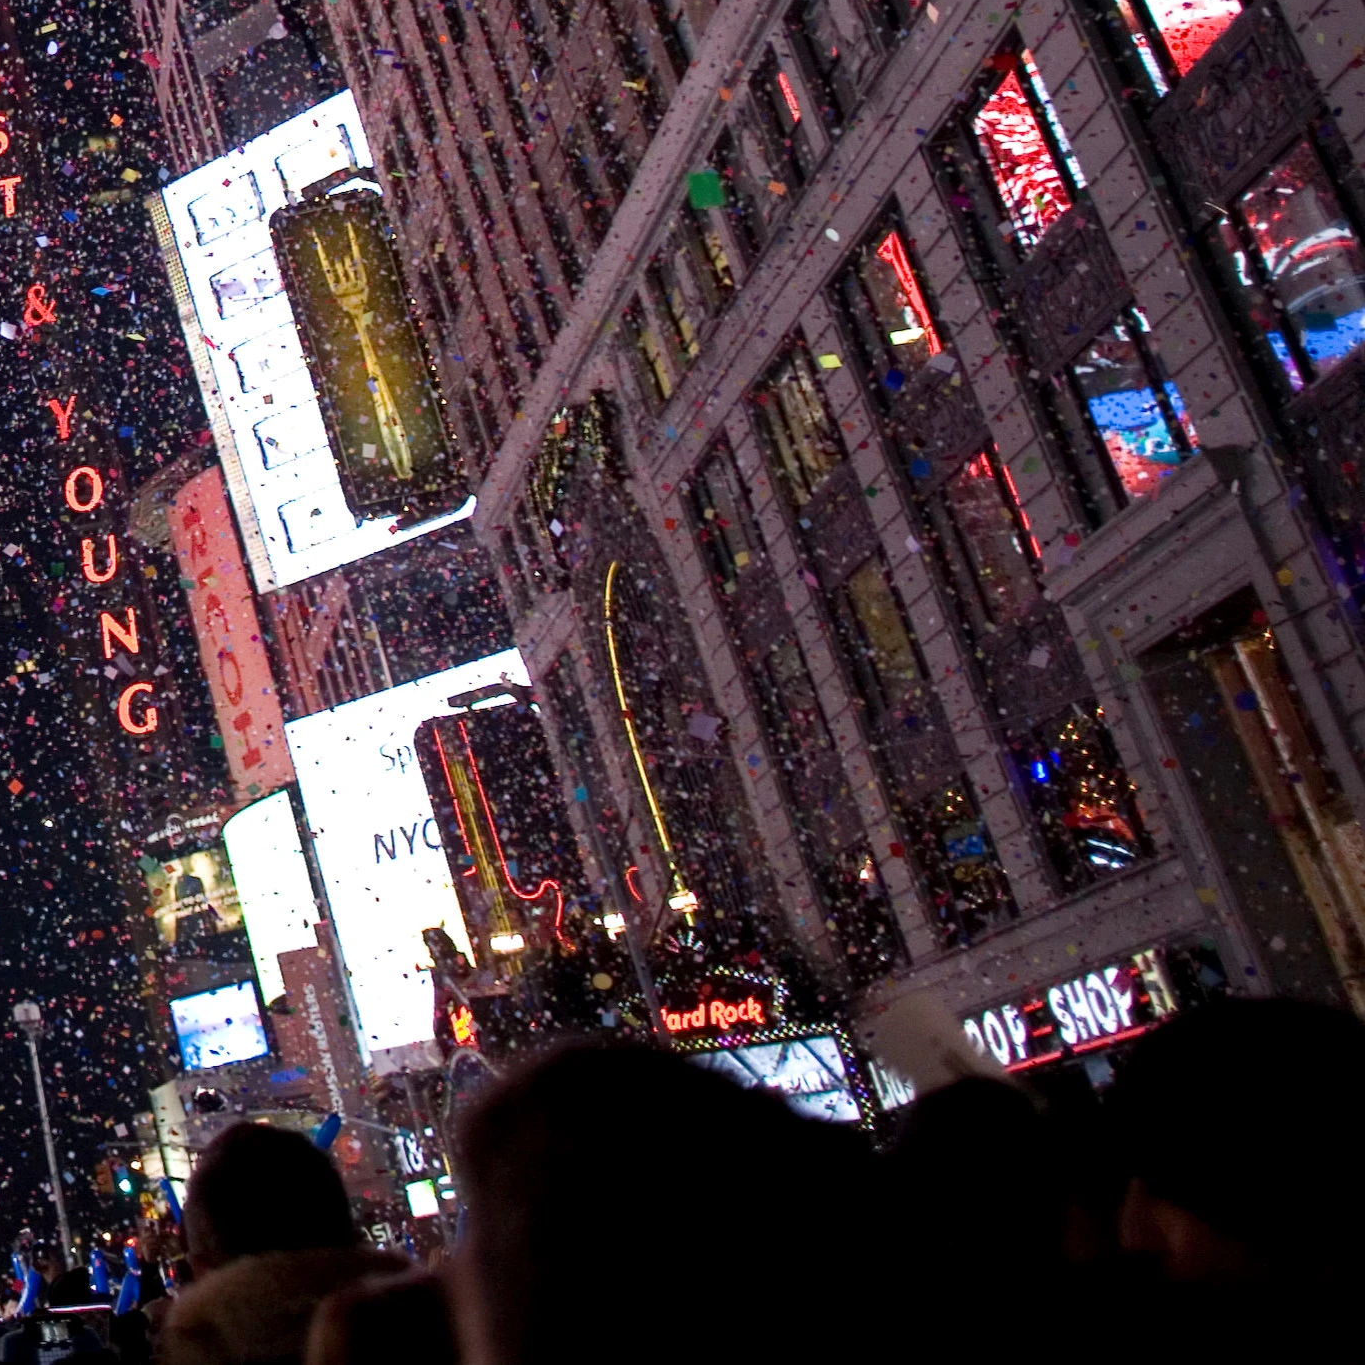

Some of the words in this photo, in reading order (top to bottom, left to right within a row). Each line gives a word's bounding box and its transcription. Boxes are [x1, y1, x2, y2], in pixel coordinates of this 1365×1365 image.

[47, 395, 158, 734] YOUNG
[656, 1004, 706, 1035] ard
[709, 995, 765, 1028] Rock
[1048, 964, 1139, 1047] SHOP
